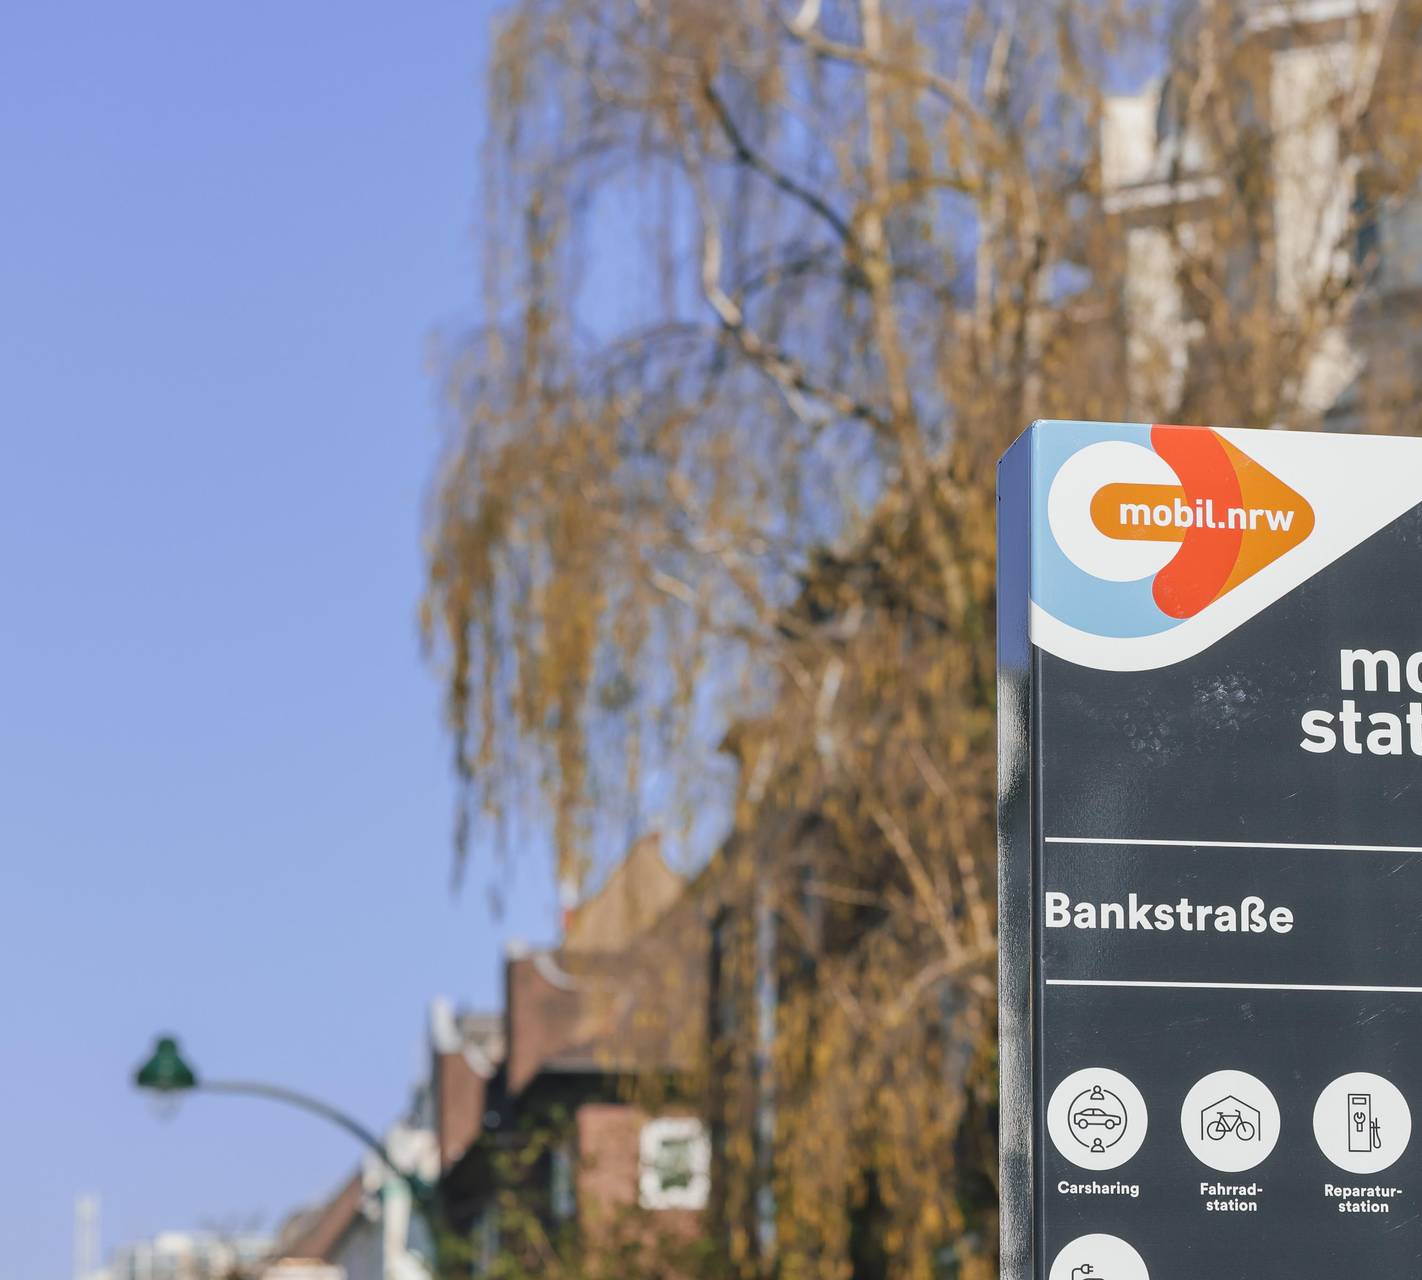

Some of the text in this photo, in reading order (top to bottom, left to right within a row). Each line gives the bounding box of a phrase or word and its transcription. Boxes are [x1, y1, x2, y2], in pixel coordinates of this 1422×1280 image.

[1121, 500, 1294, 531] mobil.nrw
[1045, 892, 1294, 933] Bankstraße
[1058, 1181, 1140, 1198] Carsharing
[1201, 1183, 1263, 1196] Fahrrad-
[1325, 1184, 1403, 1199] Reparatur-
[1206, 1198, 1258, 1212] station
[1338, 1200, 1389, 1213] station
